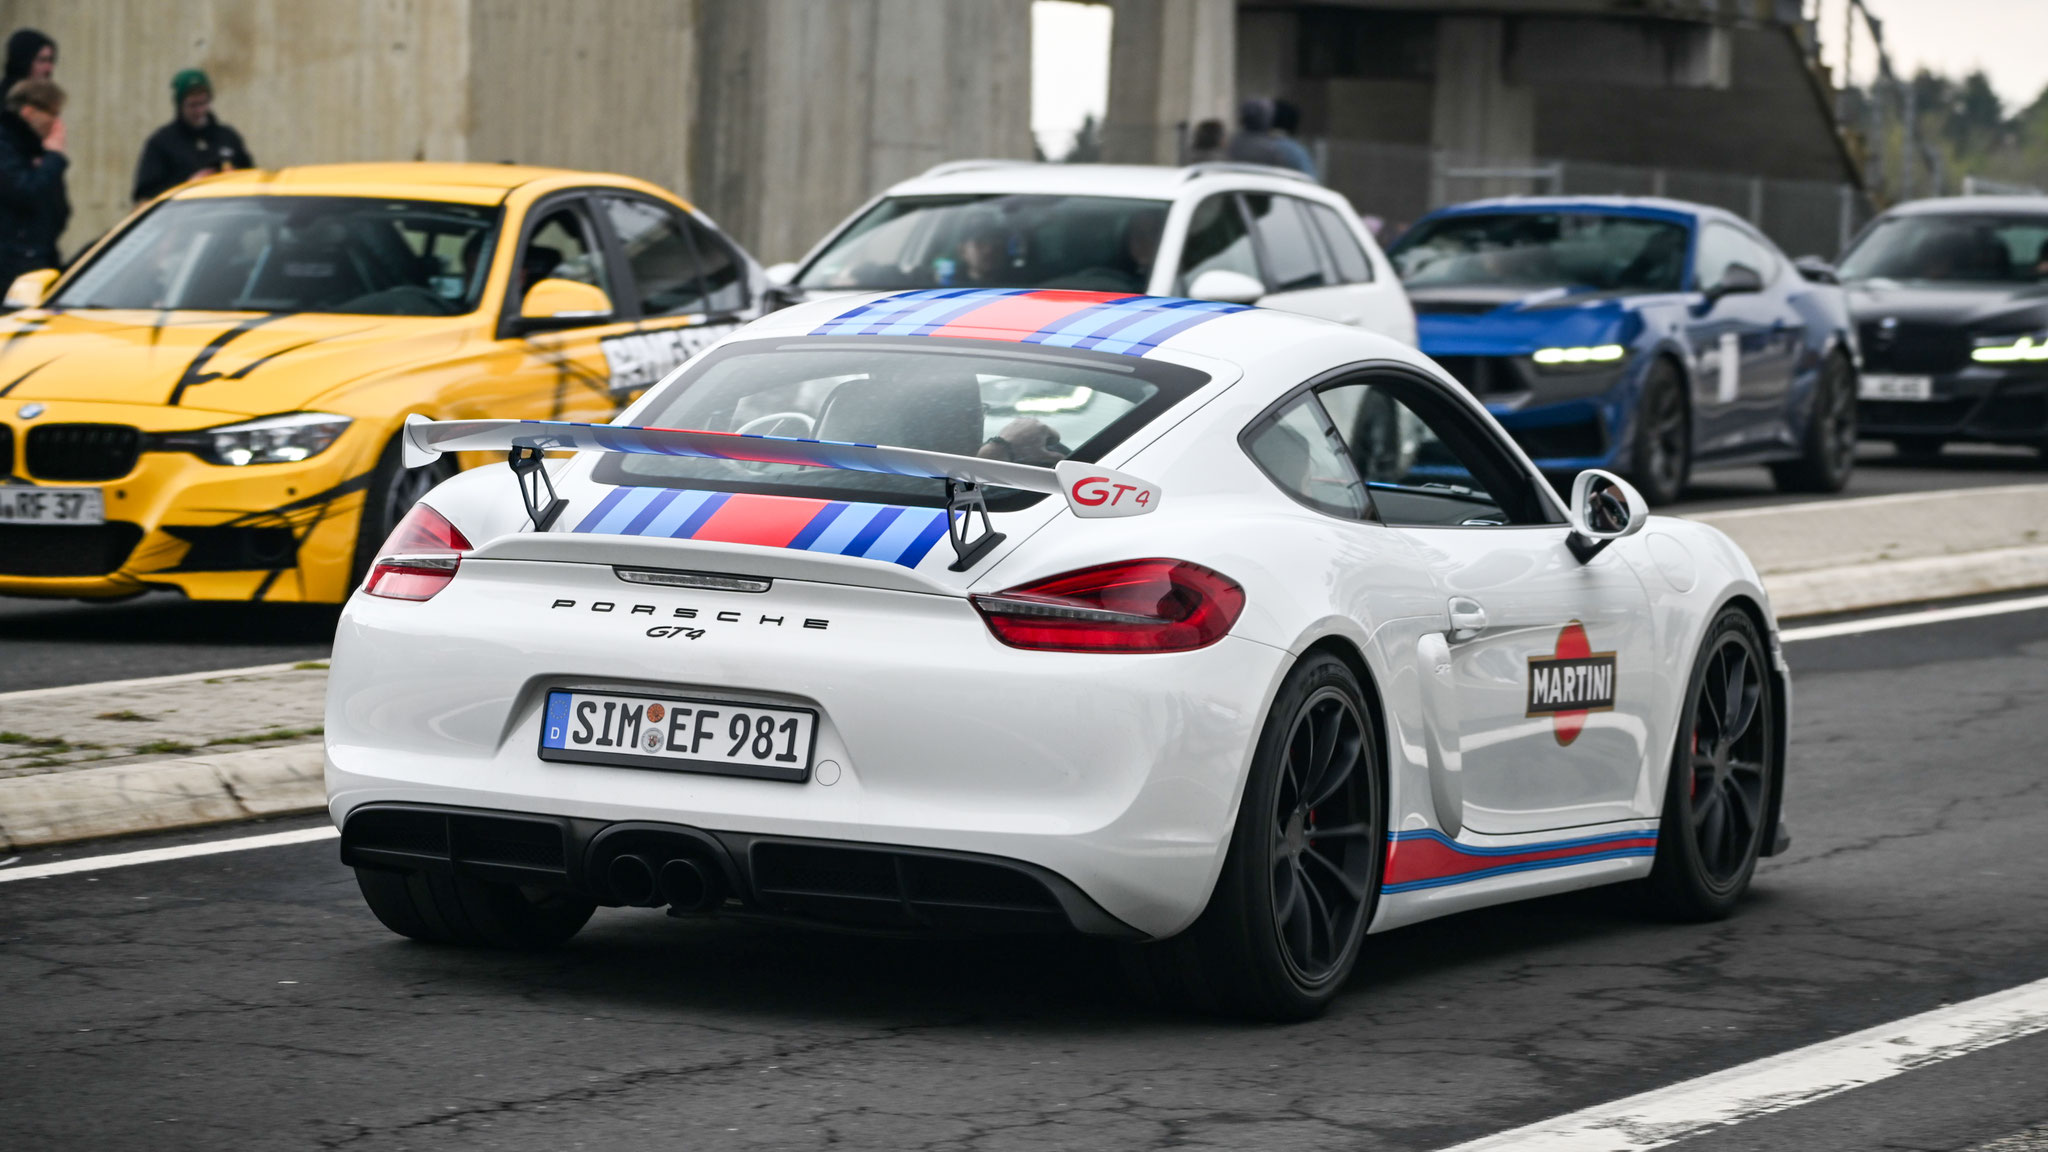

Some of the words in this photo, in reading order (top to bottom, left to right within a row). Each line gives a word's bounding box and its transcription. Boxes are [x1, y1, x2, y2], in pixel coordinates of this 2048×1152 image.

[53, 492, 86, 519] 37
[551, 599, 829, 630] PORSCHE
[646, 626, 706, 640] GT4
[1533, 664, 1612, 704] MARTINI
[550, 727, 560, 739] D
[572, 701, 643, 747] SIM
[665, 707, 719, 753] EF
[727, 713, 798, 762] 981
